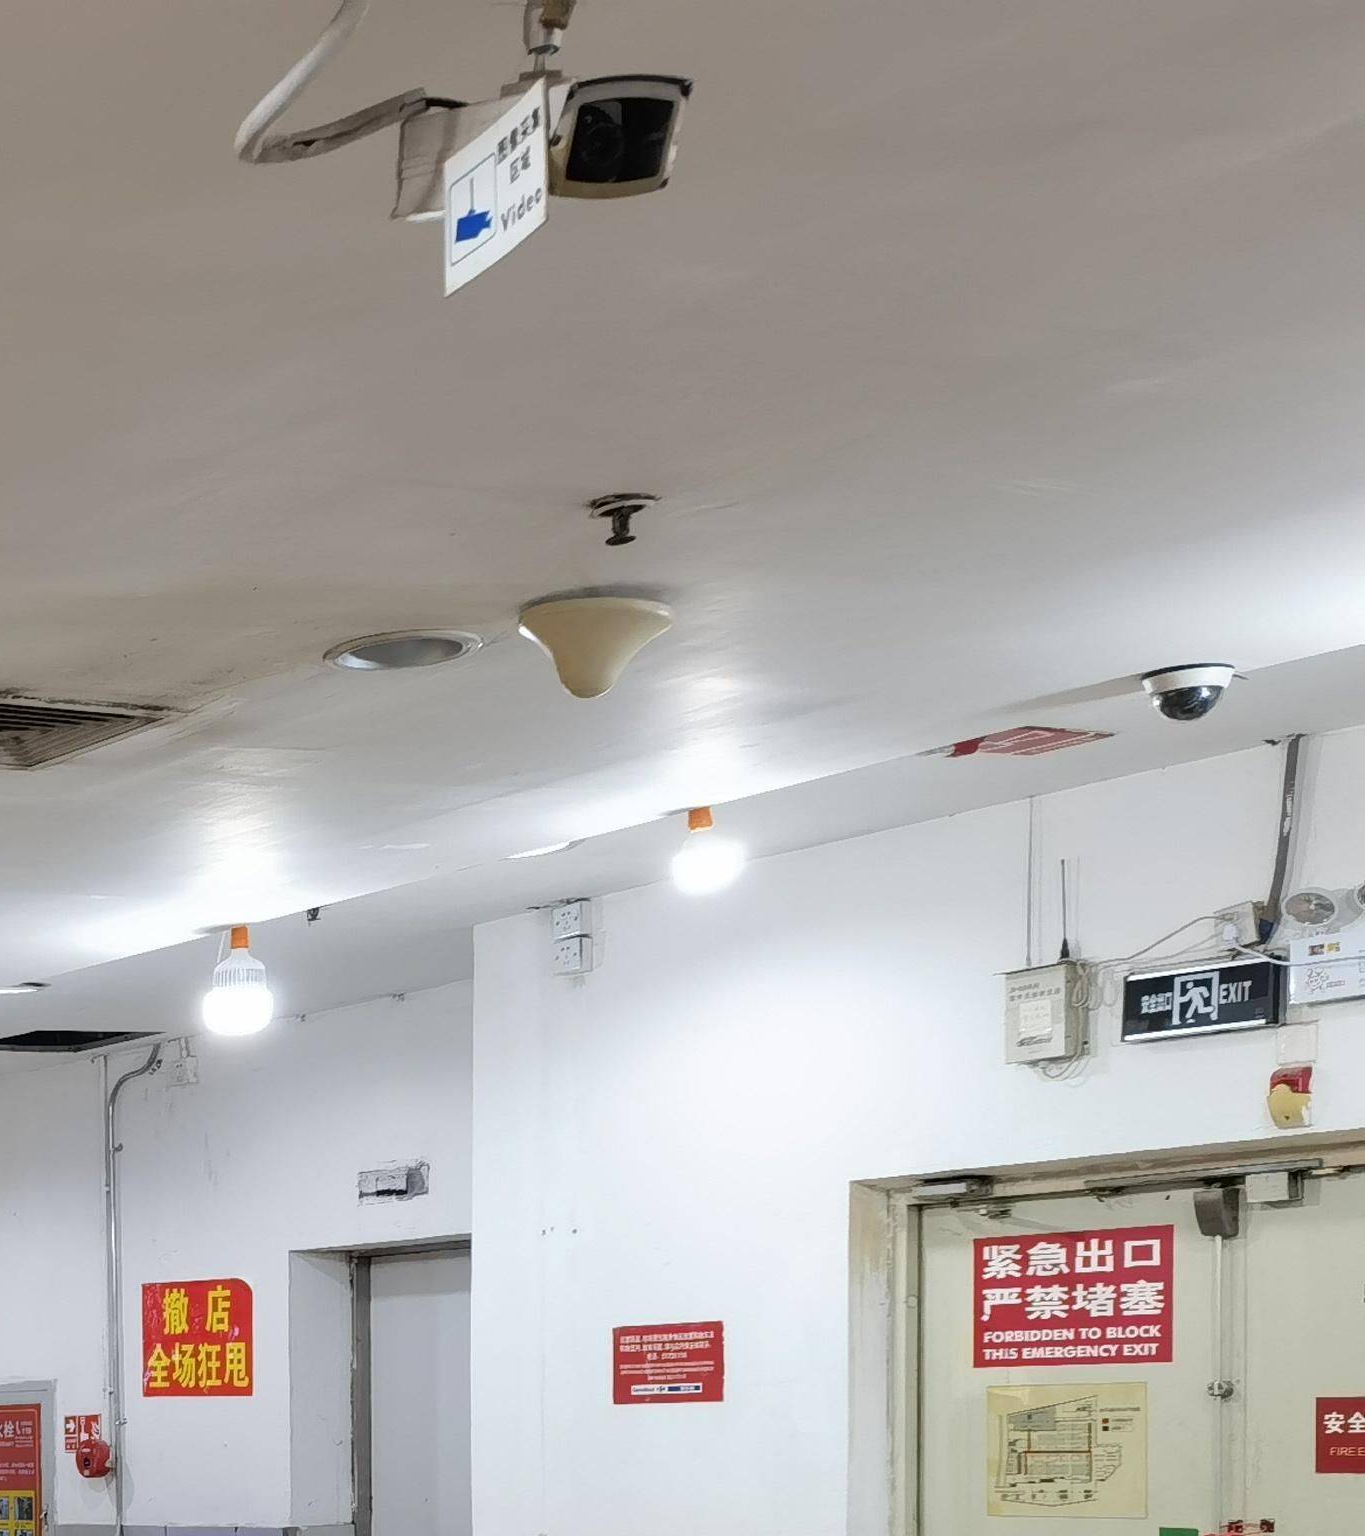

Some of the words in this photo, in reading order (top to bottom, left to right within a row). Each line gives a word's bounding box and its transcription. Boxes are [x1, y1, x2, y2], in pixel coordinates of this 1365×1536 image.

[500, 187, 542, 232] Video
[1219, 980, 1252, 1005] EXIT
[982, 1238, 1162, 1280] 紧急出口
[162, 1285, 231, 1335] 撤店
[980, 1279, 1166, 1322] 严禁堵塞
[982, 1327, 1075, 1344] FORBIDDEN
[1078, 1326, 1102, 1340] TO
[1105, 1324, 1162, 1339] BLOCK
[148, 1342, 250, 1389] 全场狂甩
[982, 1347, 1019, 1361] THIS
[1021, 1343, 1119, 1360] EMERGENCY
[1122, 1342, 1160, 1356] EXIT
[1323, 1411, 1365, 1434] 安全
[1329, 1446, 1353, 1457] FIRE
